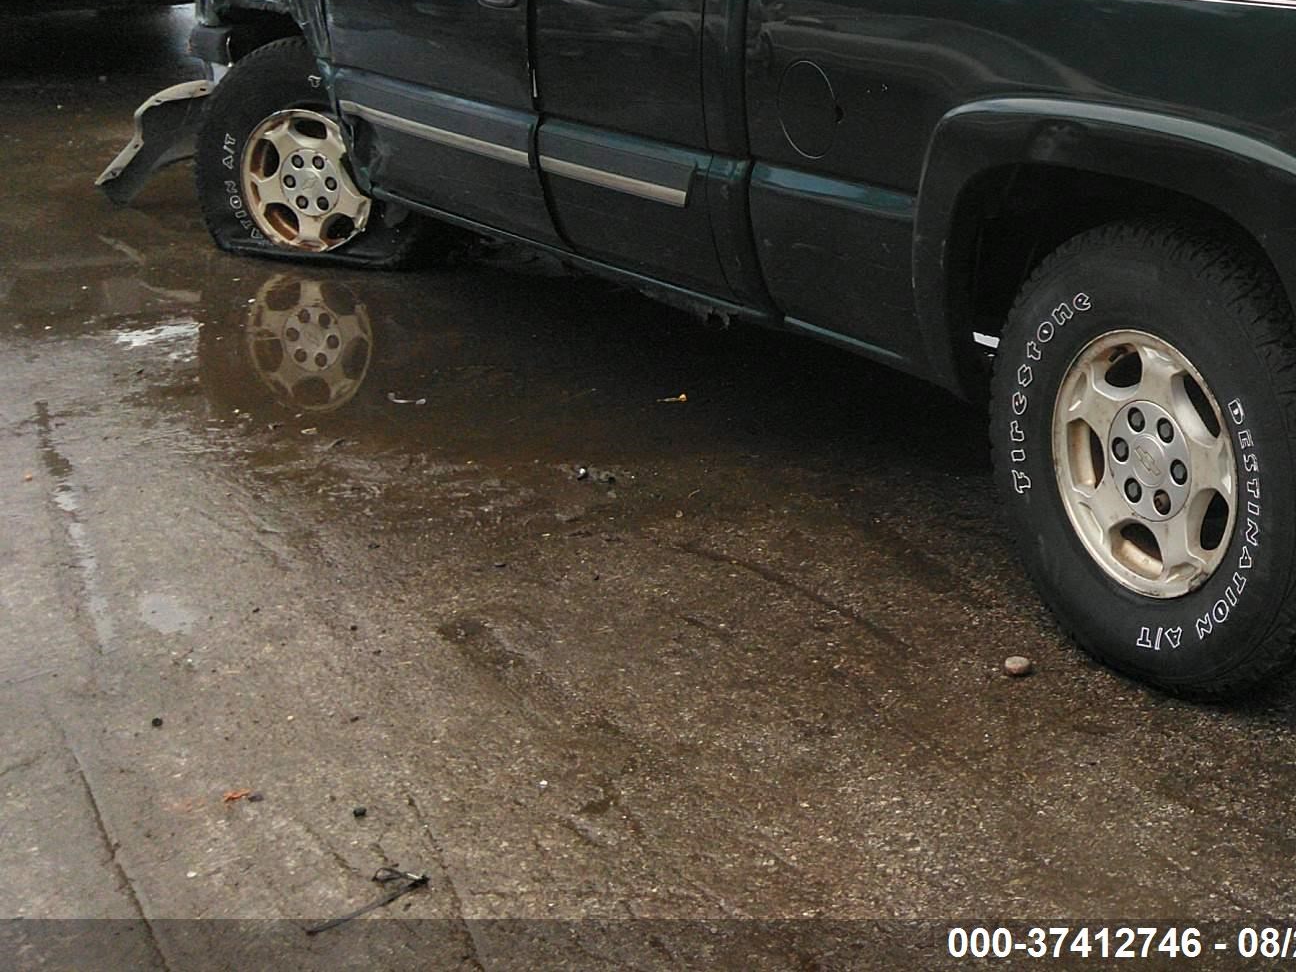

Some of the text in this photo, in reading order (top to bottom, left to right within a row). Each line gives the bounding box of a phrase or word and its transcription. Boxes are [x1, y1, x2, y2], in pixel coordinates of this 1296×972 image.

[222, 133, 237, 169] A/T
[1010, 292, 1093, 495] Firestone
[1136, 397, 1261, 650] DESTINATION A/T
